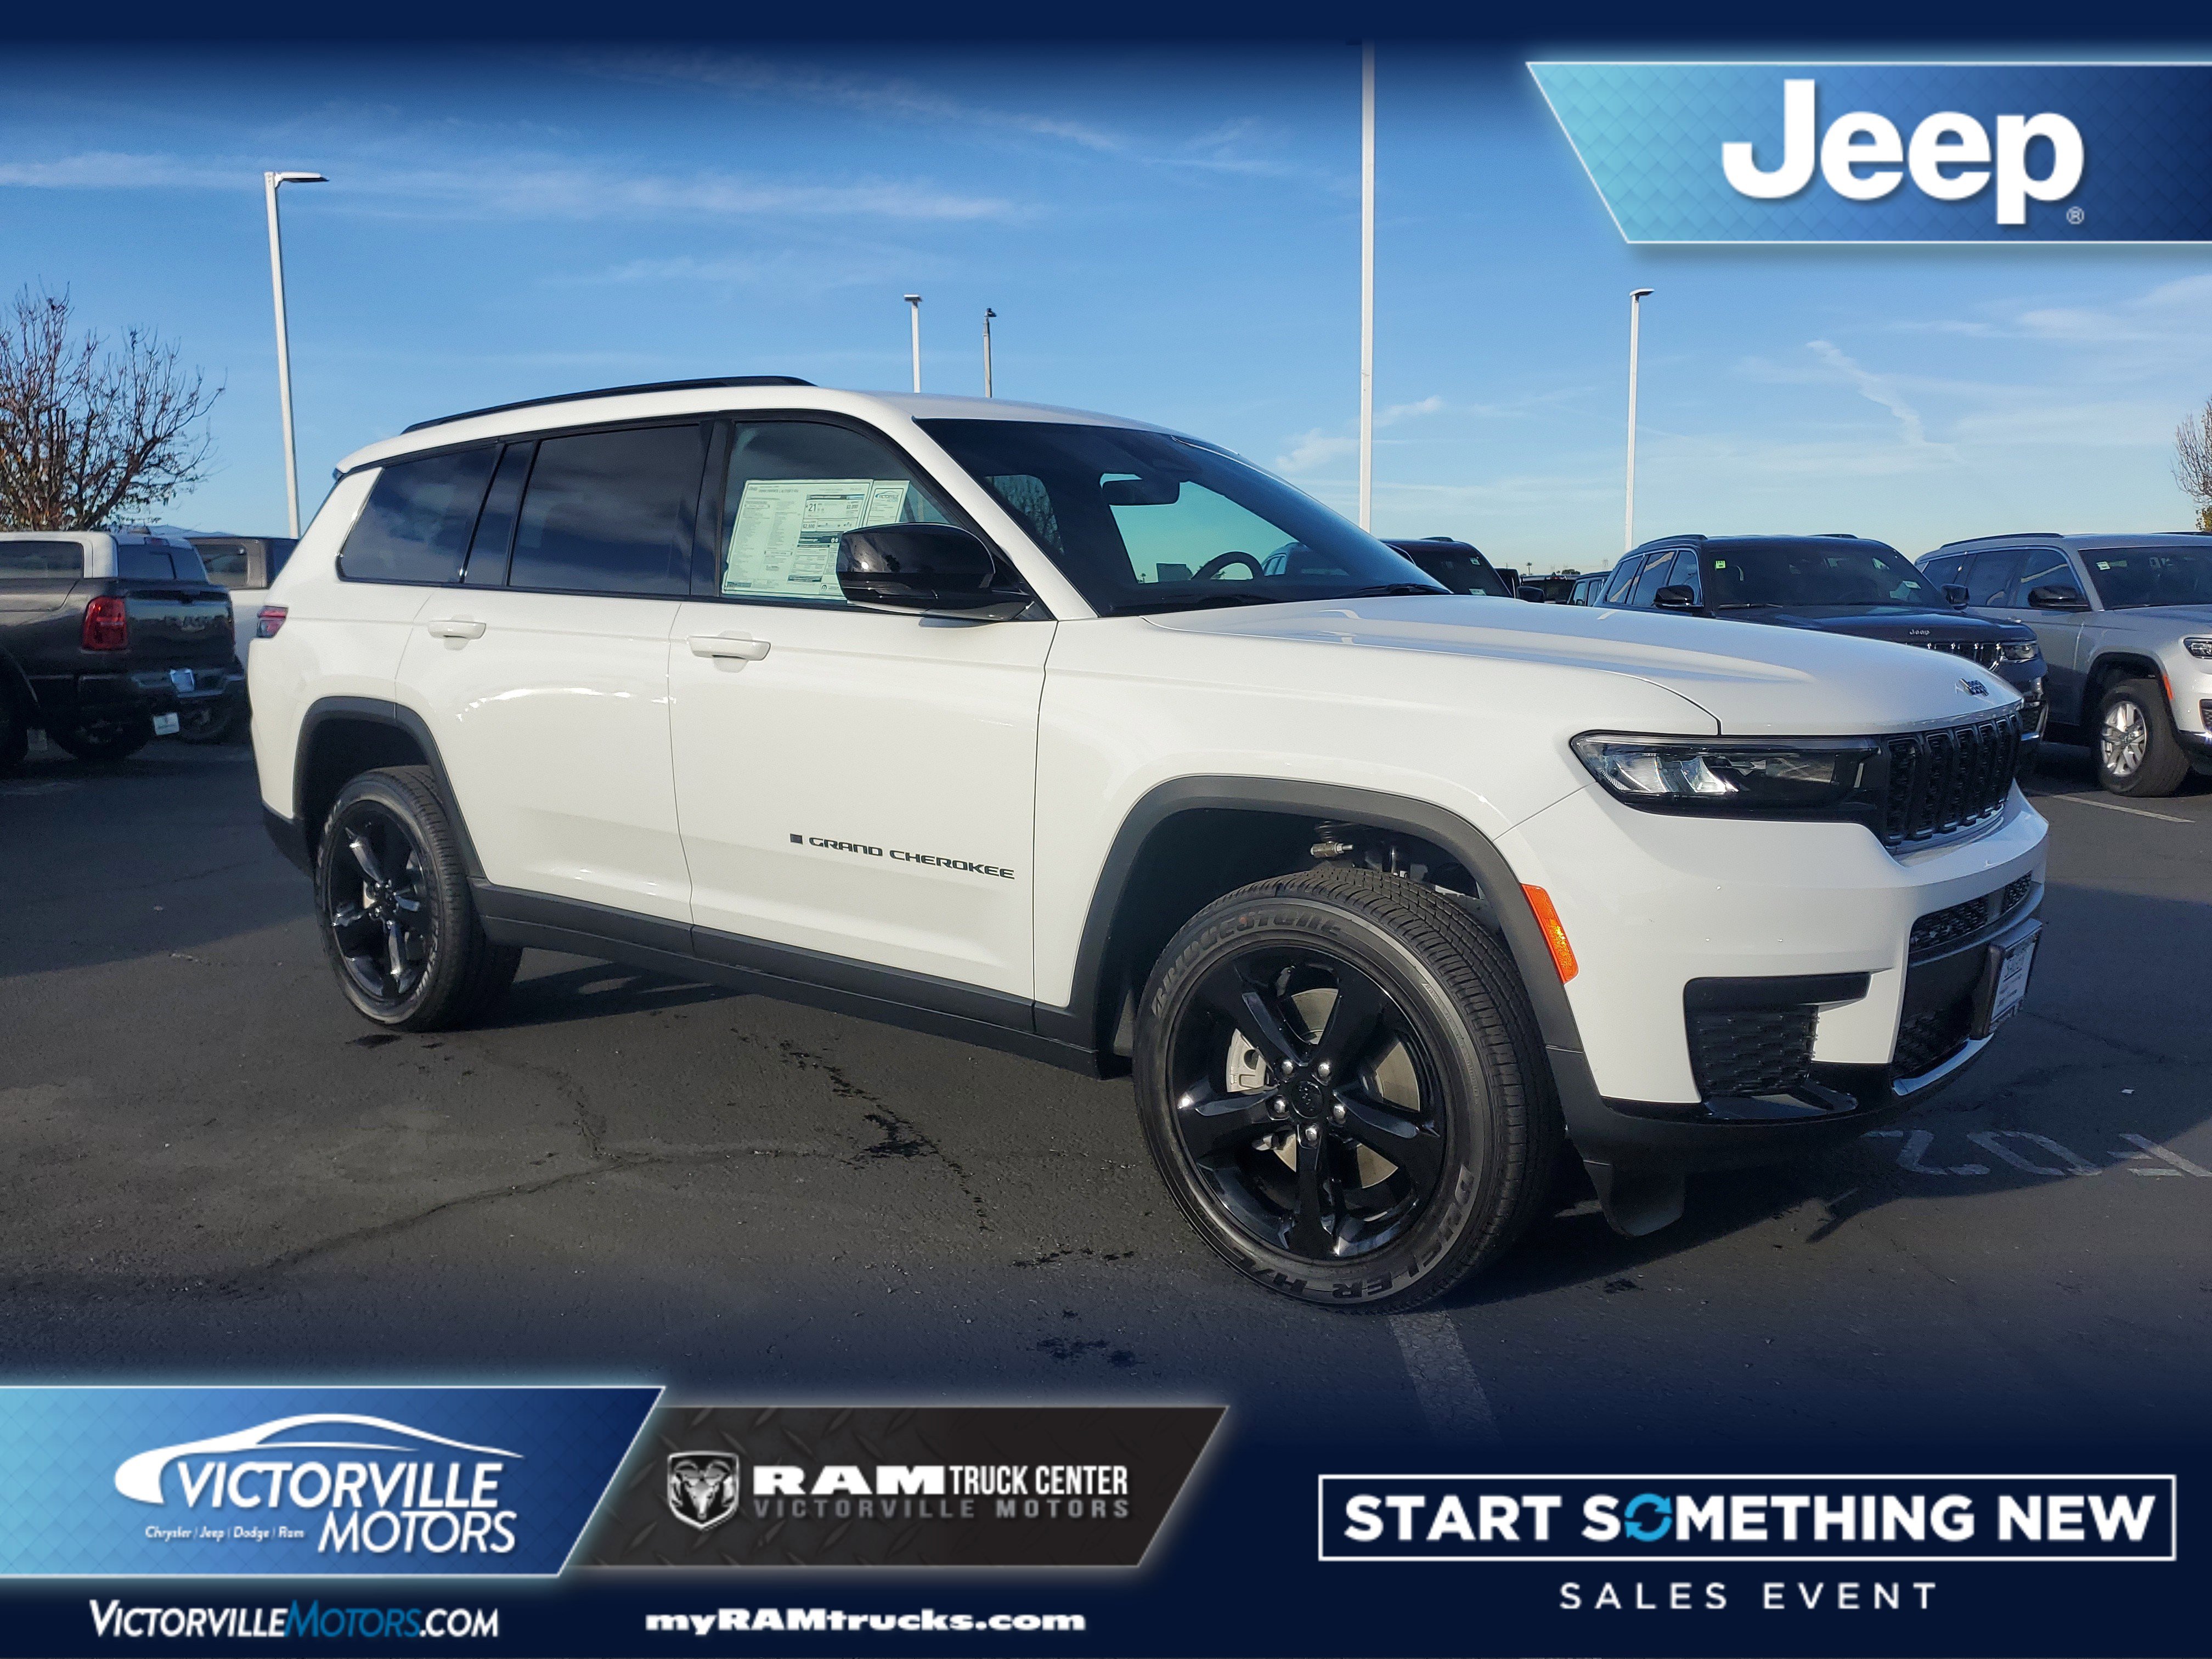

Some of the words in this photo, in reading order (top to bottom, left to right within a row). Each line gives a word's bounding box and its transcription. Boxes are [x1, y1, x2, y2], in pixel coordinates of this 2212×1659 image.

[808, 503, 816, 511] 21
[809, 837, 883, 856] GRAND
[889, 850, 1015, 880] CHEROKEE
